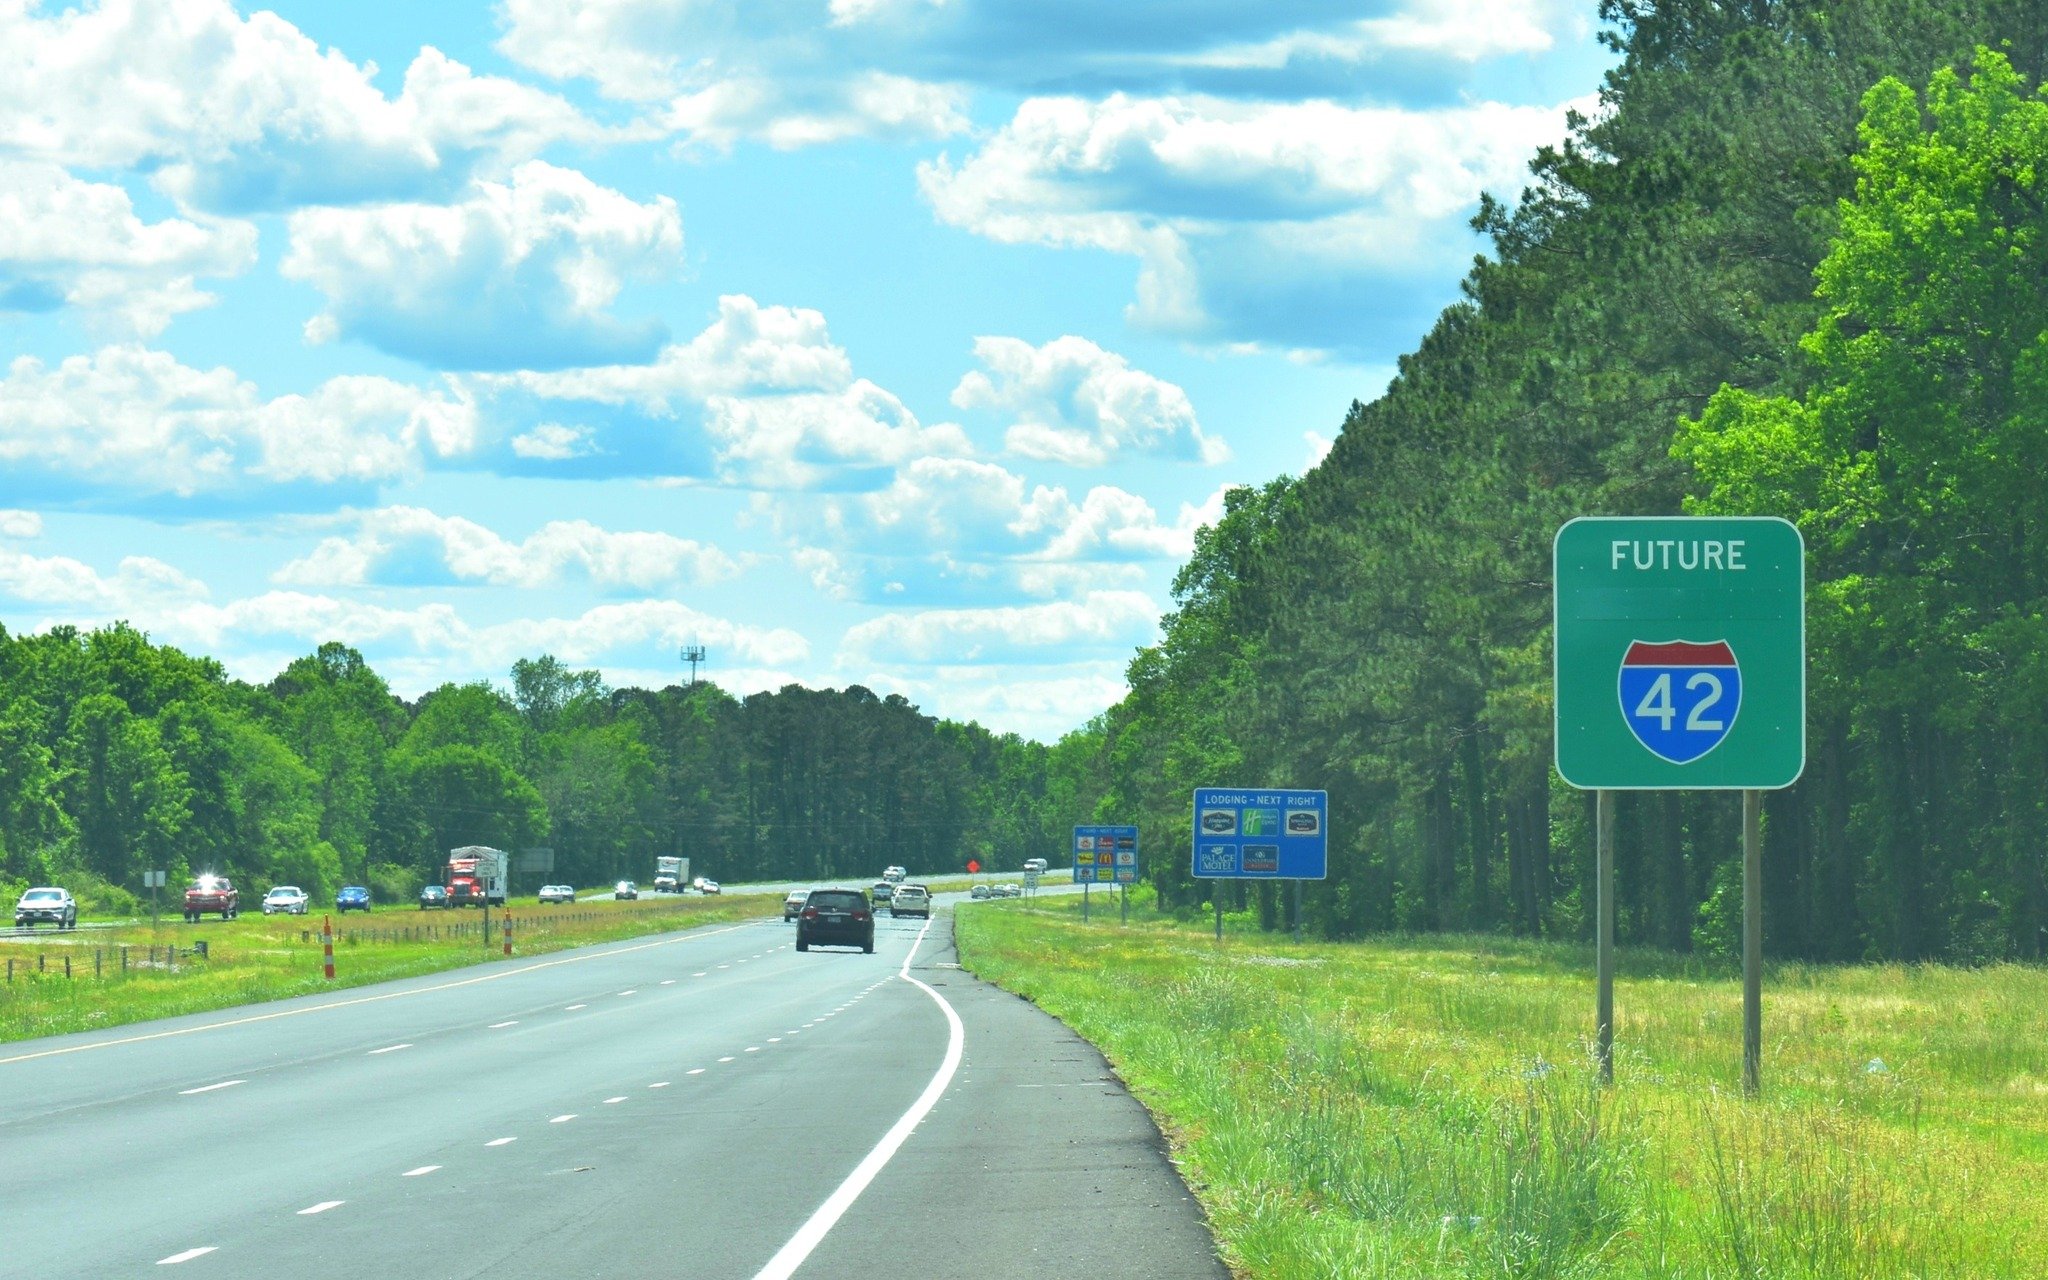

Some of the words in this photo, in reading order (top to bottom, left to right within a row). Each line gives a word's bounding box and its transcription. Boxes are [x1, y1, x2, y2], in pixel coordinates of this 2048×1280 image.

[1612, 540, 1746, 570] FUTURE
[1635, 672, 1724, 731] 42
[1205, 795, 1247, 805] LODGING
[1256, 796, 1282, 805] NEXT
[1287, 796, 1316, 806] RIGHT
[1202, 854, 1235, 862] PALACE
[1202, 861, 1232, 870] MOTEL
